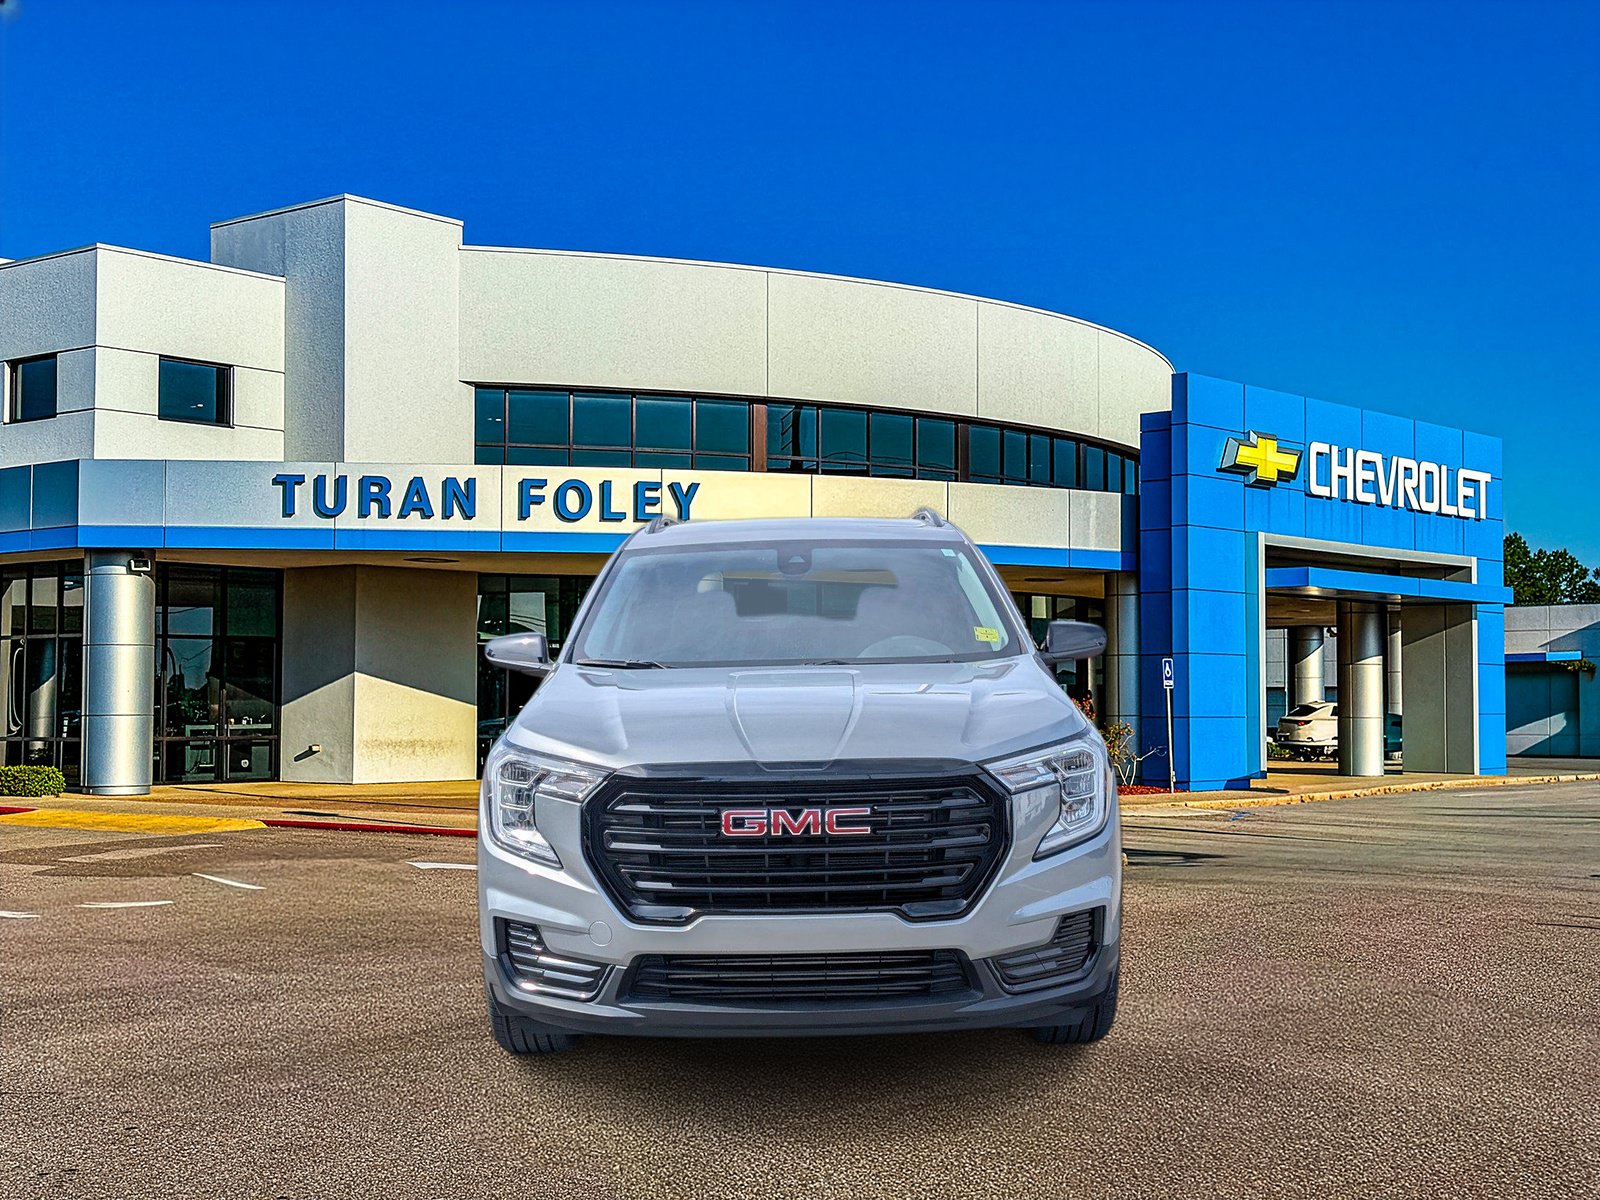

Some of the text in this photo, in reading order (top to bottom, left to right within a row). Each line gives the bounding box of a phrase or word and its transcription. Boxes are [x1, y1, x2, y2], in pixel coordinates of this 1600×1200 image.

[272, 474, 701, 523] TURAN FOLEY
[1308, 441, 1492, 520] CHEVROLET
[721, 807, 871, 836] GMC
